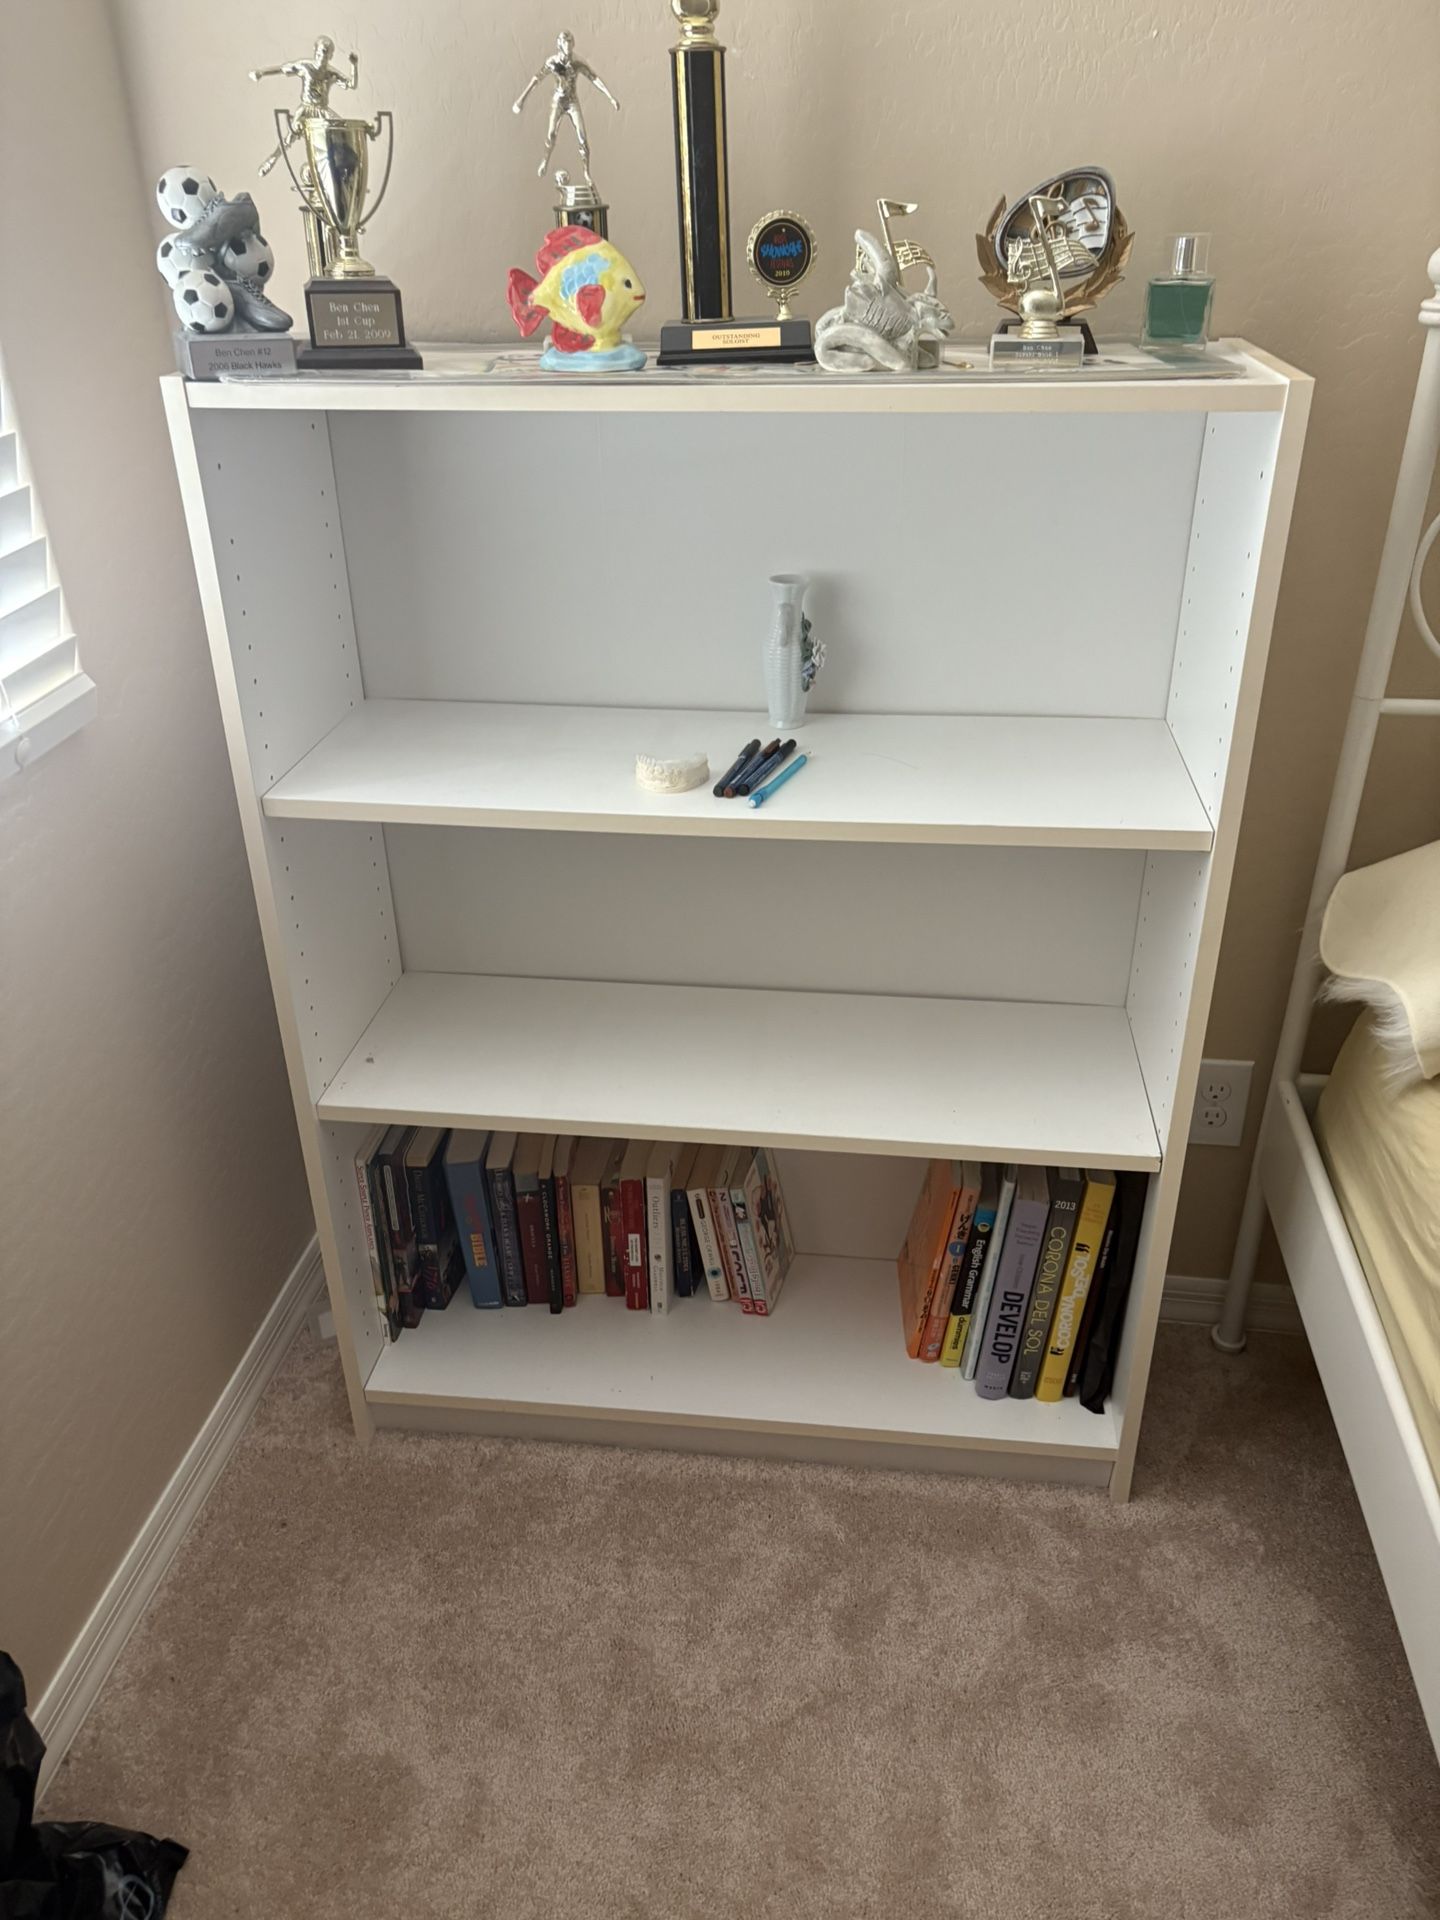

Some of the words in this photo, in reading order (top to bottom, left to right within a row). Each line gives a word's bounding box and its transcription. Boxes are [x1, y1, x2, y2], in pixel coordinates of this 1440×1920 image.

[329, 302, 348, 313] Ben
[353, 302, 380, 313] Chen
[323, 329, 343, 340] Feb
[365, 329, 392, 340] 2009
[353, 316, 376, 329] Cup
[711, 332, 760, 342] OUTSTANDING
[215, 347, 232, 358] Ben
[233, 347, 255, 357] Chen
[256, 347, 271, 357] #12
[231, 360, 254, 371] Black
[255, 360, 282, 370] Hawks
[1054, 1200, 1076, 1211] 2013
[470, 1233, 487, 1268] BIBLE
[971, 1239, 986, 1269] English
[1038, 1226, 1066, 1295] CORONA
[962, 1269, 978, 1309] Grammar
[1030, 1299, 1049, 1325] DEL
[951, 1317, 966, 1350] dummies
[991, 1291, 1024, 1364] DEVELOP
[1023, 1328, 1043, 1355] SOL
